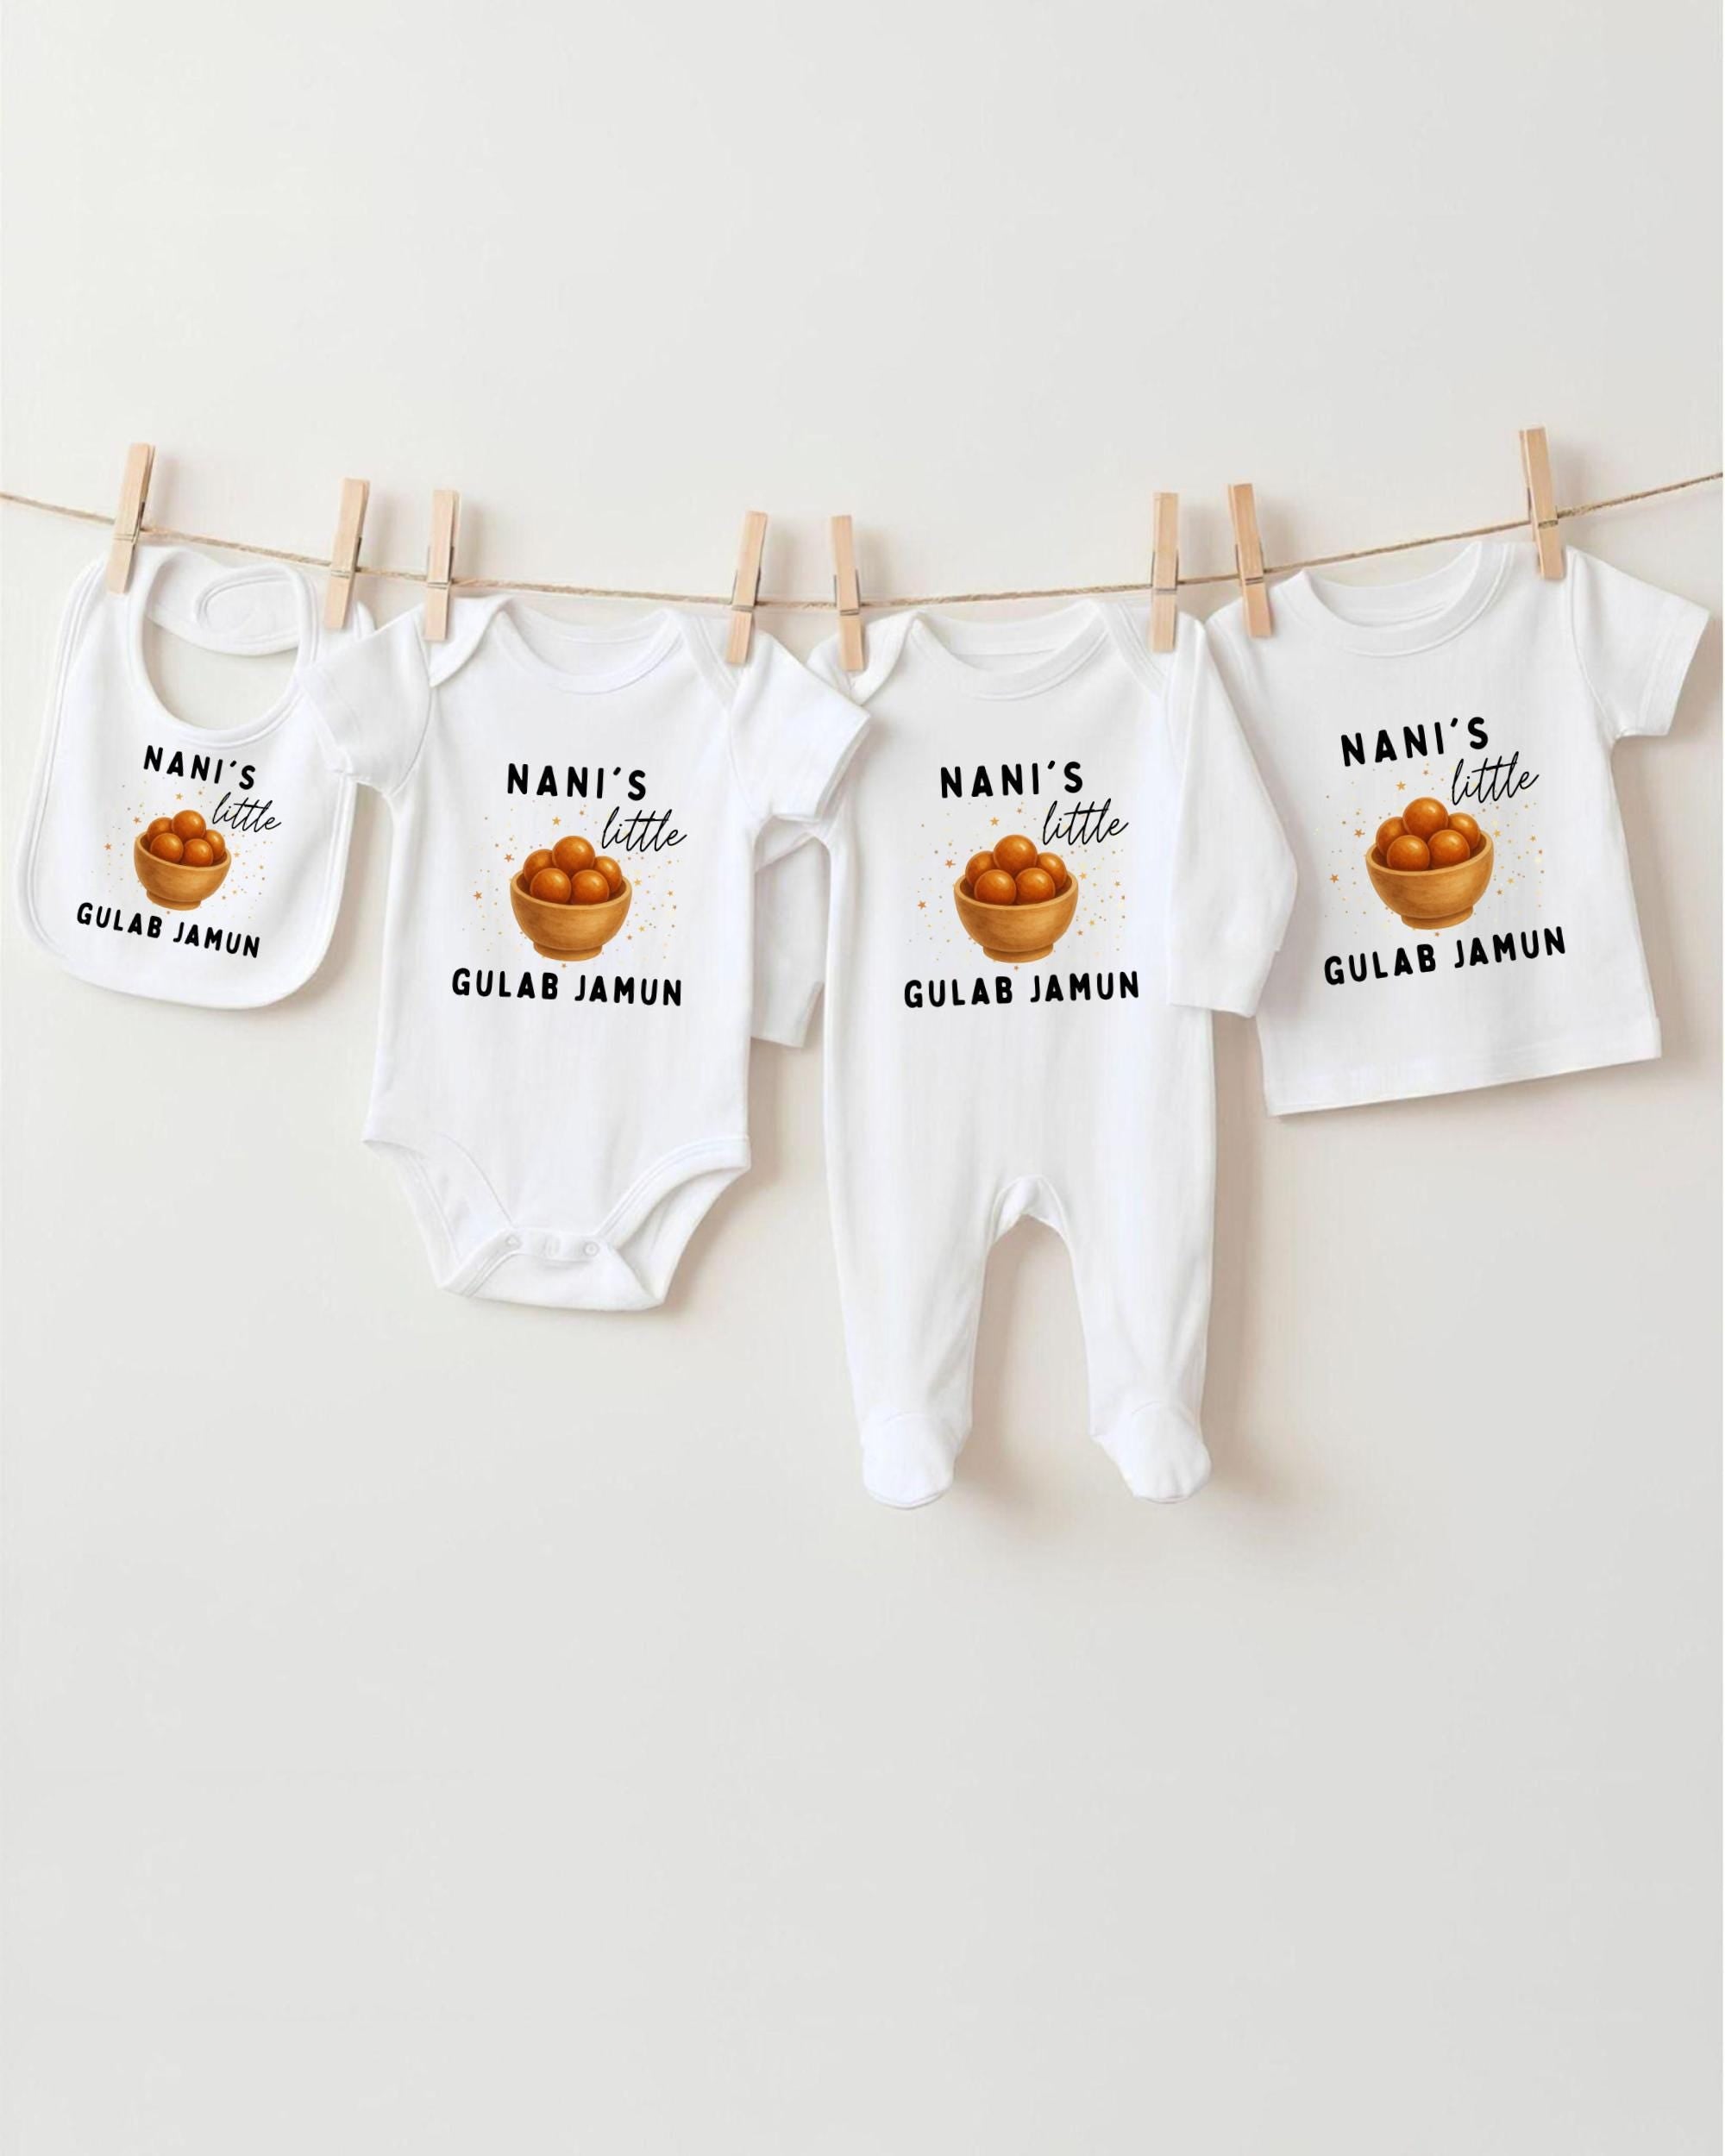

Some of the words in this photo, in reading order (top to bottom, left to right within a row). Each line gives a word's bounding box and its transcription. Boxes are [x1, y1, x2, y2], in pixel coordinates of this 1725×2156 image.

[1340, 717, 1489, 768] NANI'S
[143, 744, 256, 791] NANI'S
[507, 762, 646, 801] NANI'S
[940, 760, 1083, 799] NANI'S
[1452, 750, 1540, 806] little
[211, 792, 282, 833] little
[601, 805, 688, 853] little
[1042, 798, 1129, 846] little
[77, 902, 163, 939] GULAB
[172, 922, 260, 959] JAMUN
[1324, 943, 1436, 986] GULAB
[1454, 925, 1565, 968] JAMUN
[452, 968, 559, 1000] GULAB
[574, 975, 681, 1006] JAMUN
[904, 975, 1013, 1009] GULAB
[1030, 970, 1139, 1003] JAMUN
